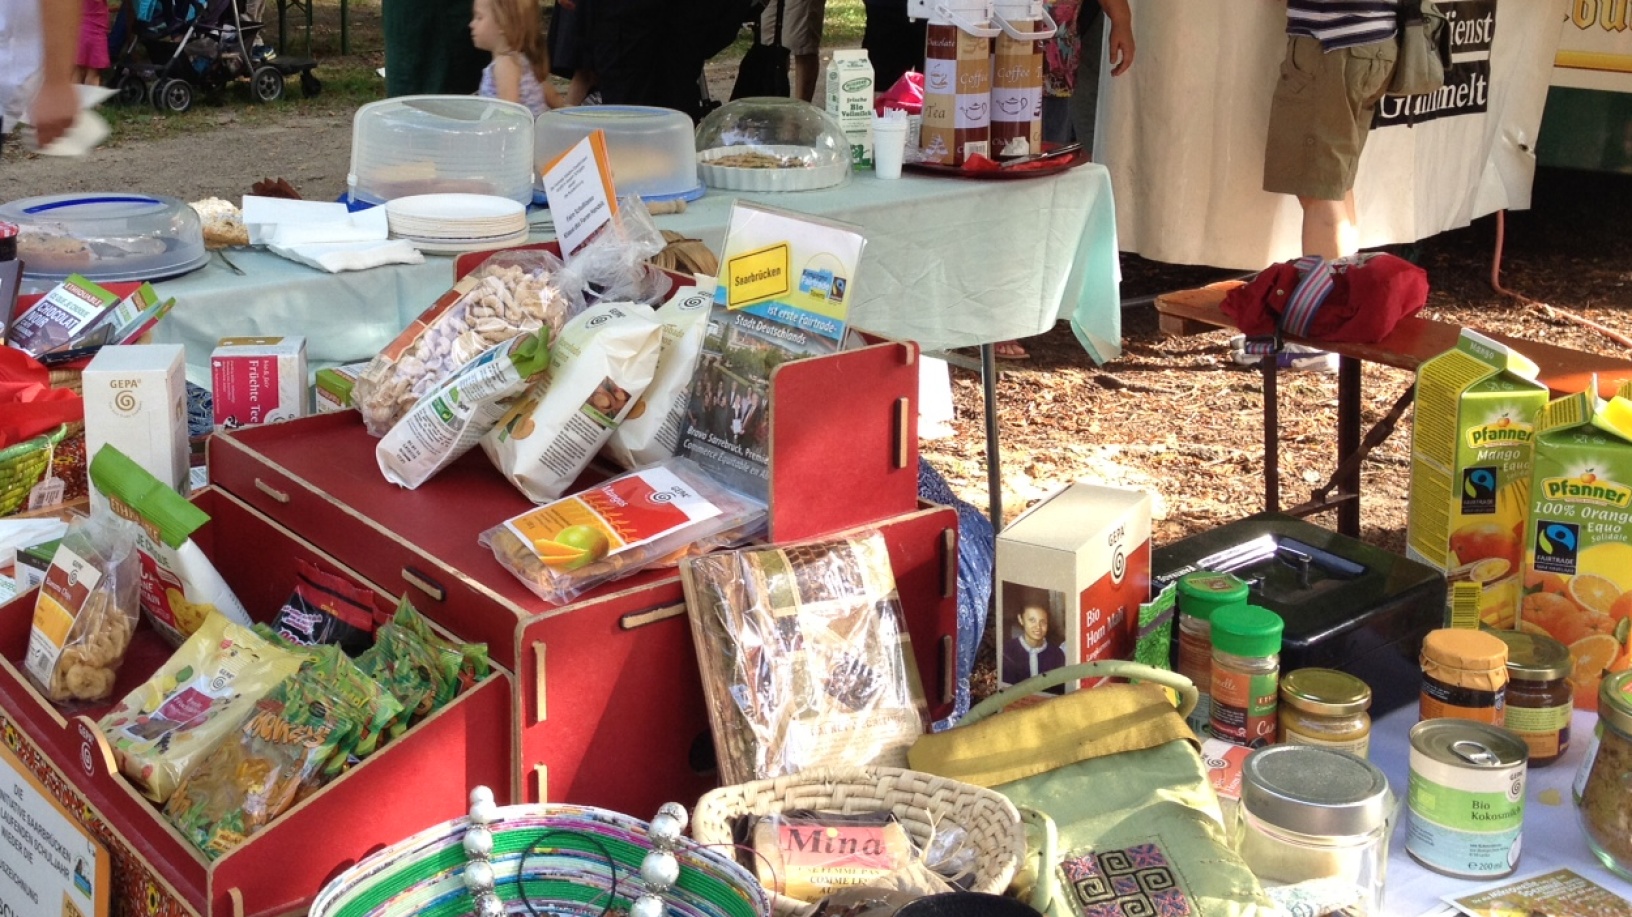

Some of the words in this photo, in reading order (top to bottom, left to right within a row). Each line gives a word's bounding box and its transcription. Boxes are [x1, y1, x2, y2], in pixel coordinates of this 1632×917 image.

[1445, 10, 1493, 46] ienst
[997, 65, 1030, 82] Coffee
[926, 102, 945, 119] Tea
[734, 266, 782, 287] Saarbrücken
[37, 302, 80, 330] CHOCOLAT
[767, 305, 778, 316] ist
[778, 308, 799, 322] erste
[799, 314, 838, 334] Fairtrade-
[734, 314, 758, 330] Stadt
[756, 318, 808, 346] Deutschlands
[1470, 341, 1495, 360] Mango
[110, 379, 138, 389] GEPA
[248, 359, 259, 402] Früchte
[250, 405, 261, 423] Tee
[687, 425, 707, 441] Bravo
[1477, 450, 1520, 461] Mango
[1534, 501, 1576, 517] 100%
[1108, 525, 1125, 547] GEPA
[1587, 522, 1622, 533] Equo
[1591, 533, 1628, 543] solidale
[1537, 554, 1574, 565] FAIRTRADE
[1086, 607, 1100, 628] Bio
[13, 783, 24, 801] DIE
[1471, 805, 1521, 821] Kokosmilch
[1472, 800, 1490, 810] Bio
[784, 827, 884, 856] Mina
[1478, 862, 1493, 870] 200
[810, 876, 850, 885] COMME
